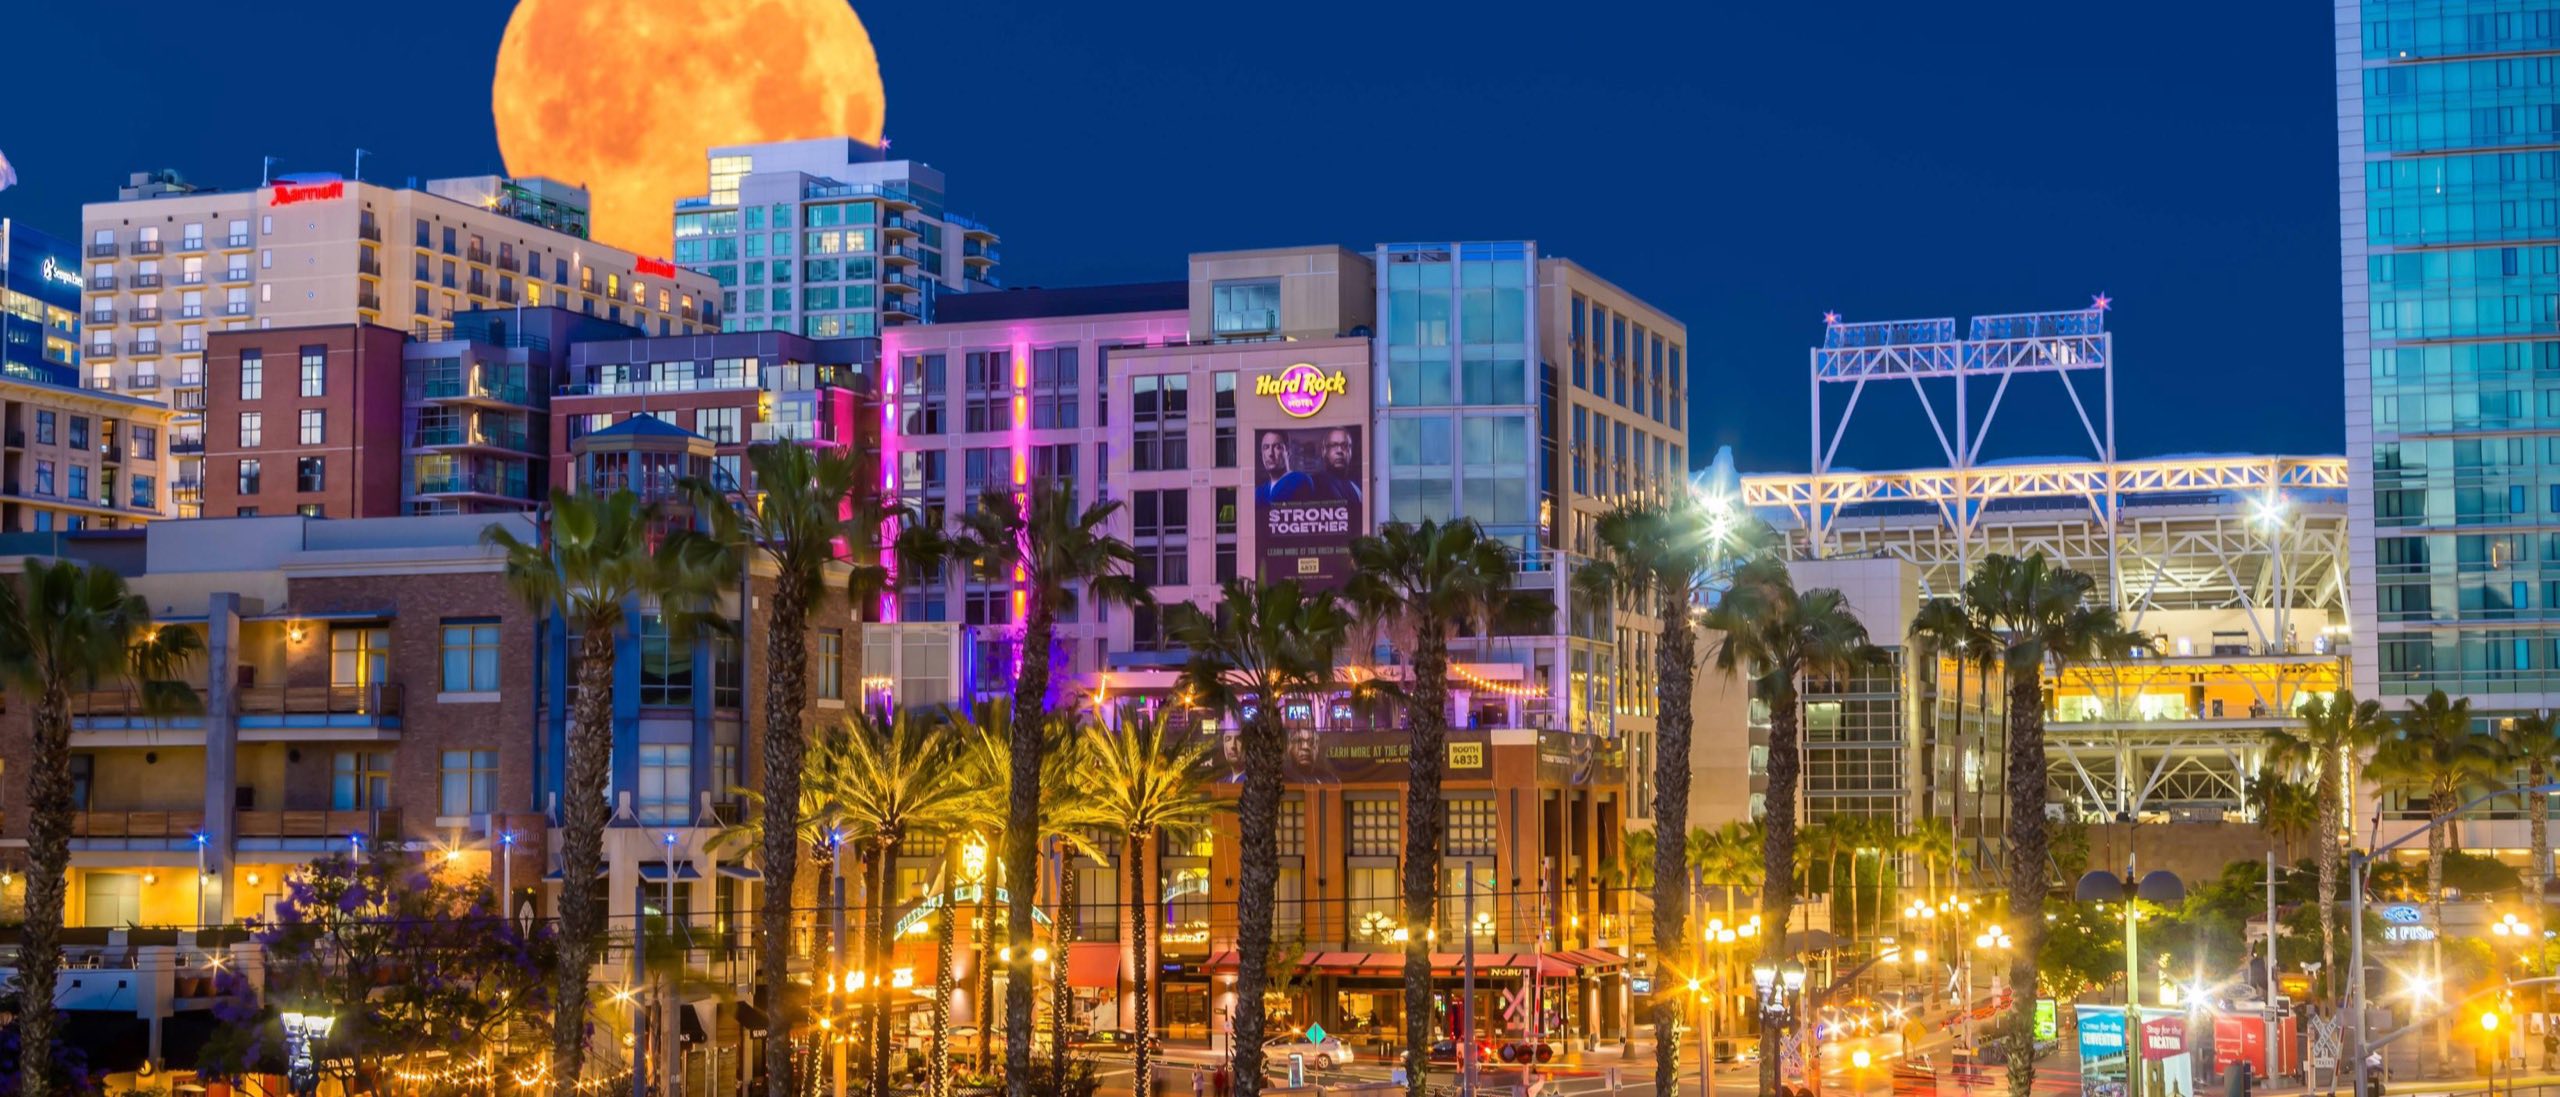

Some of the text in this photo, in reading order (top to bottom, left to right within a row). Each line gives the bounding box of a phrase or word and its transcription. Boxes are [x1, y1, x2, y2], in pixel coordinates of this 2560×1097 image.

[271, 182, 343, 206] Marriott
[1256, 371, 1346, 397] Hard Rock
[1288, 398, 1313, 408] HOTEL
[1269, 507, 1348, 522] STRONG
[1269, 521, 1348, 534] TOGETHER
[1327, 746, 1349, 757] LEARN
[1351, 746, 1371, 757] MORE
[1373, 745, 1382, 757] AT
[1384, 745, 1397, 756] THE
[1452, 746, 1479, 754] BOOTH
[1453, 755, 1479, 765] 4833
[1491, 968, 1522, 976] NOBU
[2149, 1036, 2181, 1050] VACATION
